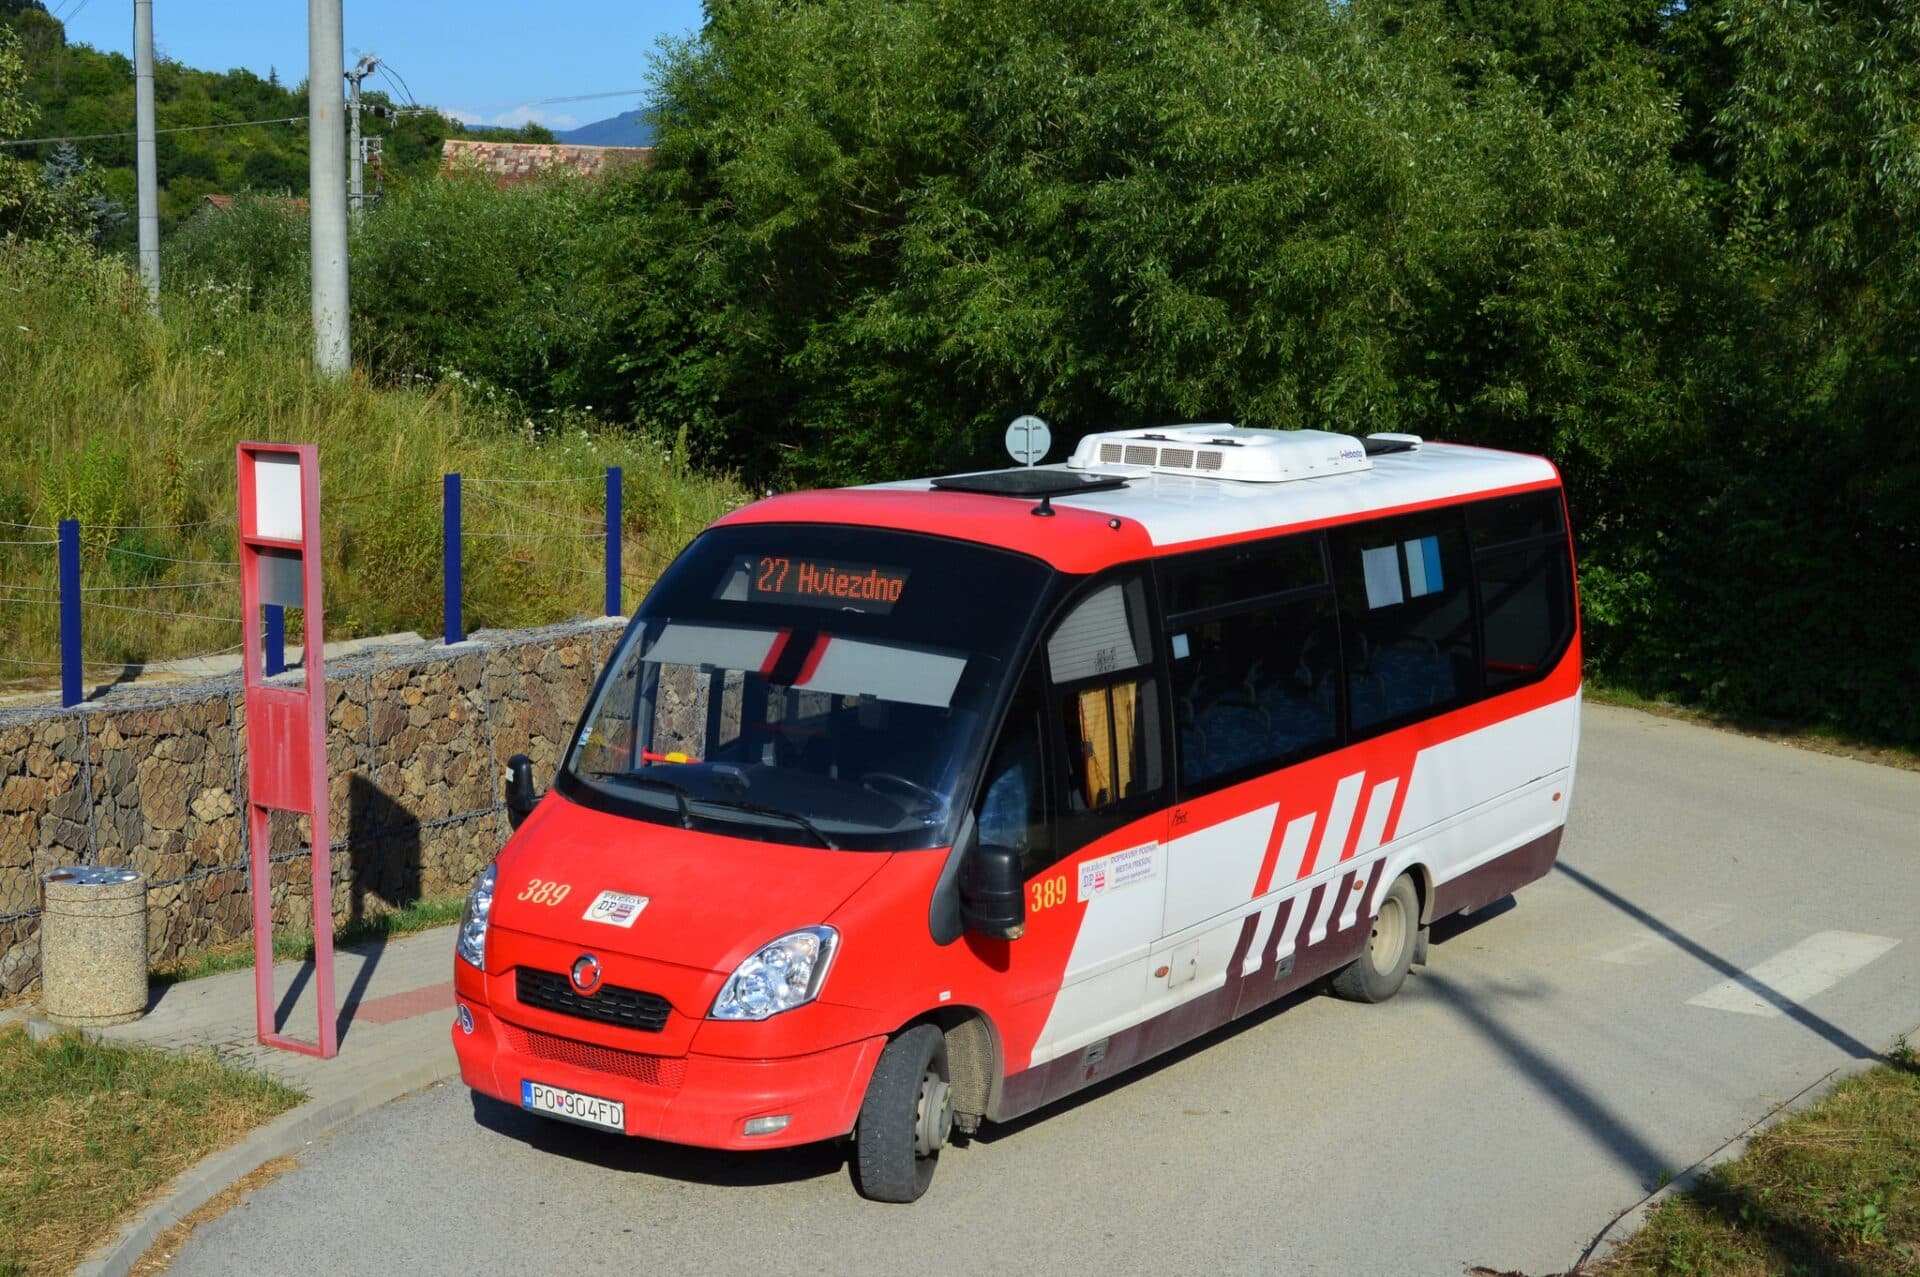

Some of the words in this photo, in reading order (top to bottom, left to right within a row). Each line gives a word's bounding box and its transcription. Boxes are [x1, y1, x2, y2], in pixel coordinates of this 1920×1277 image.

[757, 556, 790, 592] 27
[797, 562, 903, 602] Hviezdno
[517, 878, 572, 907] 389
[1031, 875, 1067, 912] 389
